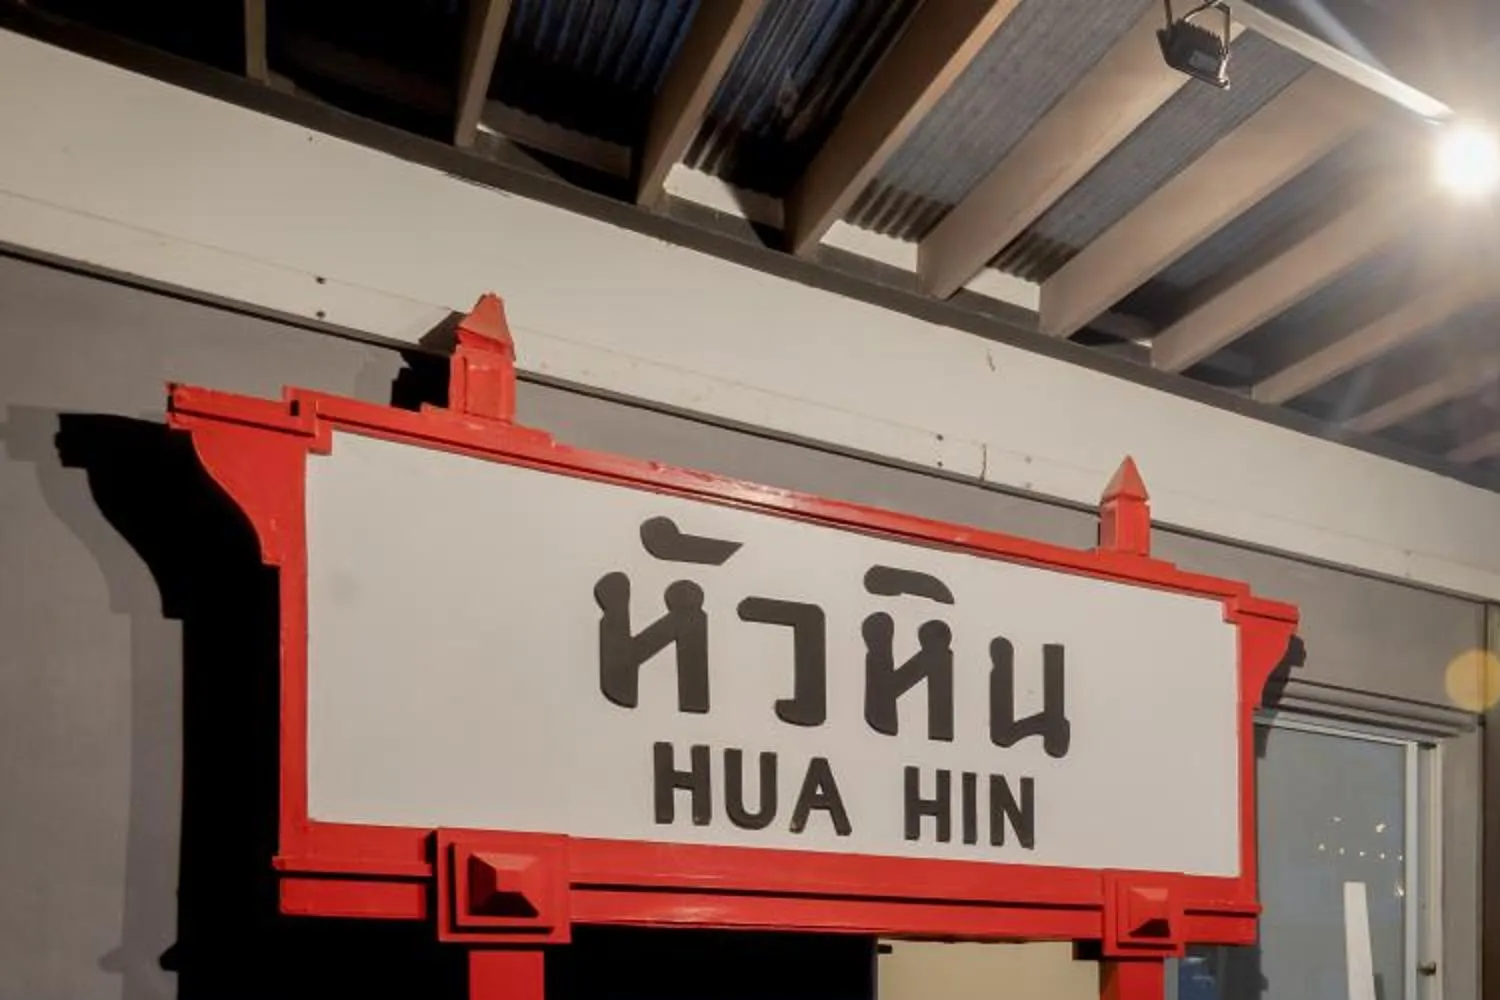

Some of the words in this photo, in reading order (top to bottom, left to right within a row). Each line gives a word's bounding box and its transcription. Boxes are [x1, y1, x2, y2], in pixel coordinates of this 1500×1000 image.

[594, 516, 1071, 758] หัวหิน
[653, 741, 852, 836] HUA
[903, 765, 1035, 850] HIN
